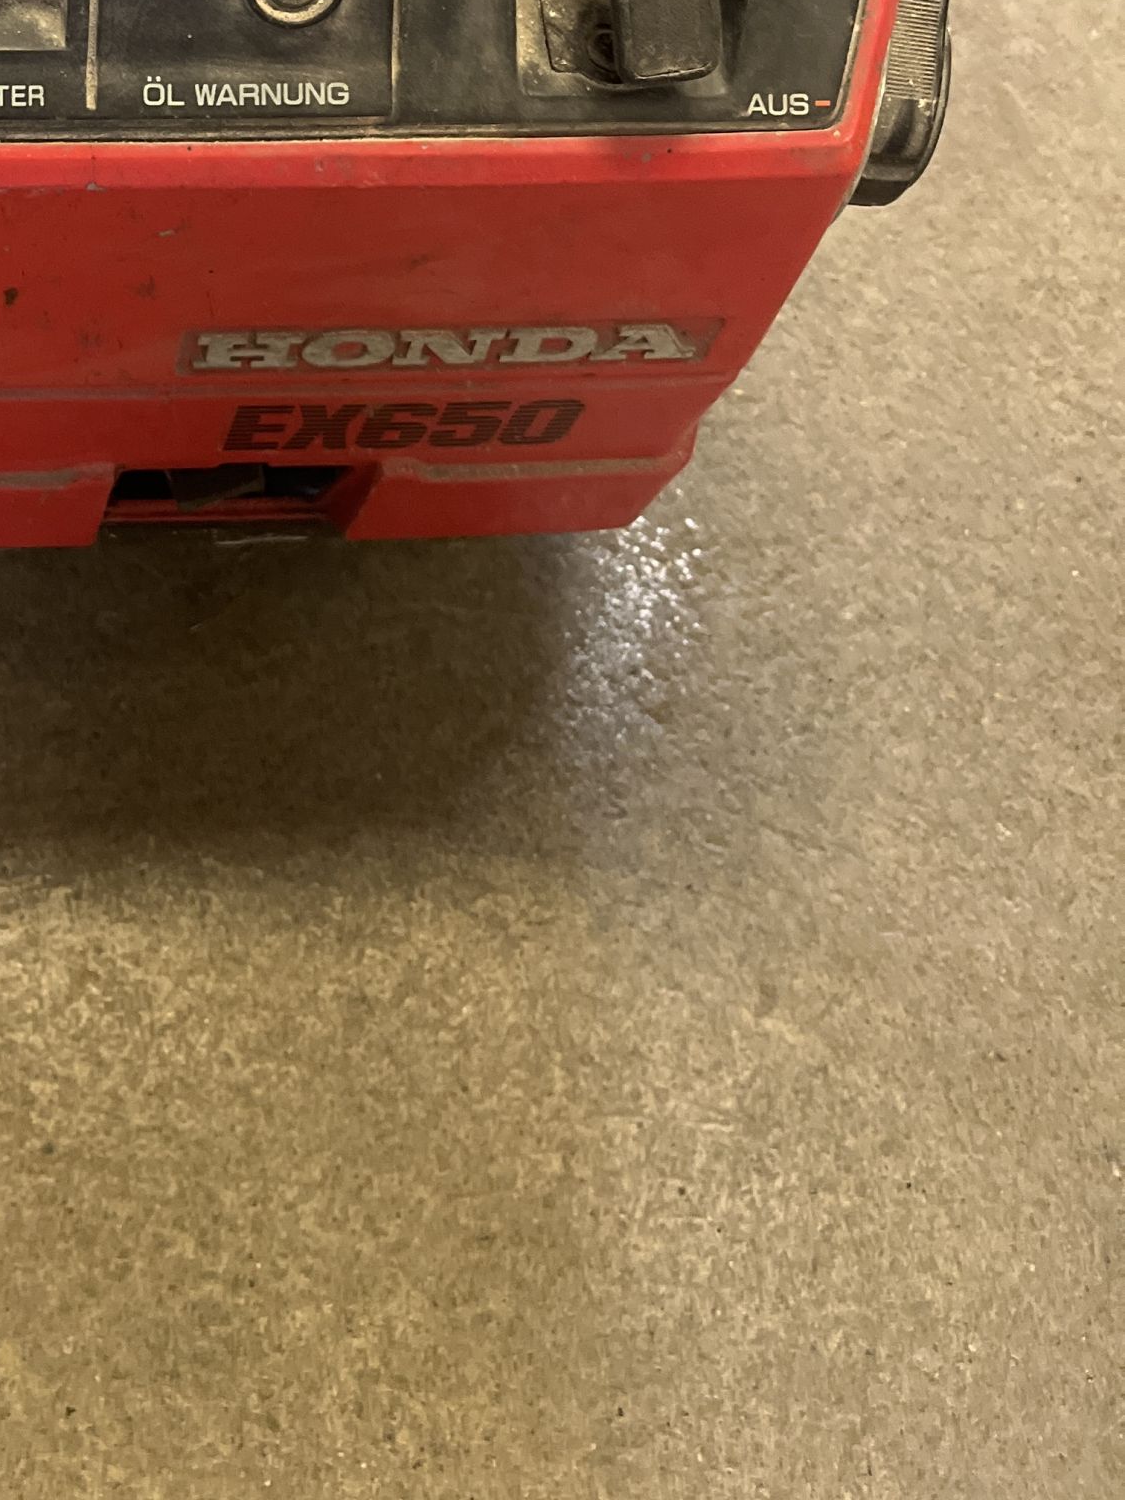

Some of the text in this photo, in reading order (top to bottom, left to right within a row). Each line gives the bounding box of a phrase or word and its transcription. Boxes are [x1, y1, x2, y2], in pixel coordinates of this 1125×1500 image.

[142, 75, 350, 107] ÖL WARNUNG
[747, 93, 810, 116] AUS
[192, 324, 695, 368] HONDA
[222, 400, 585, 452] EX650
